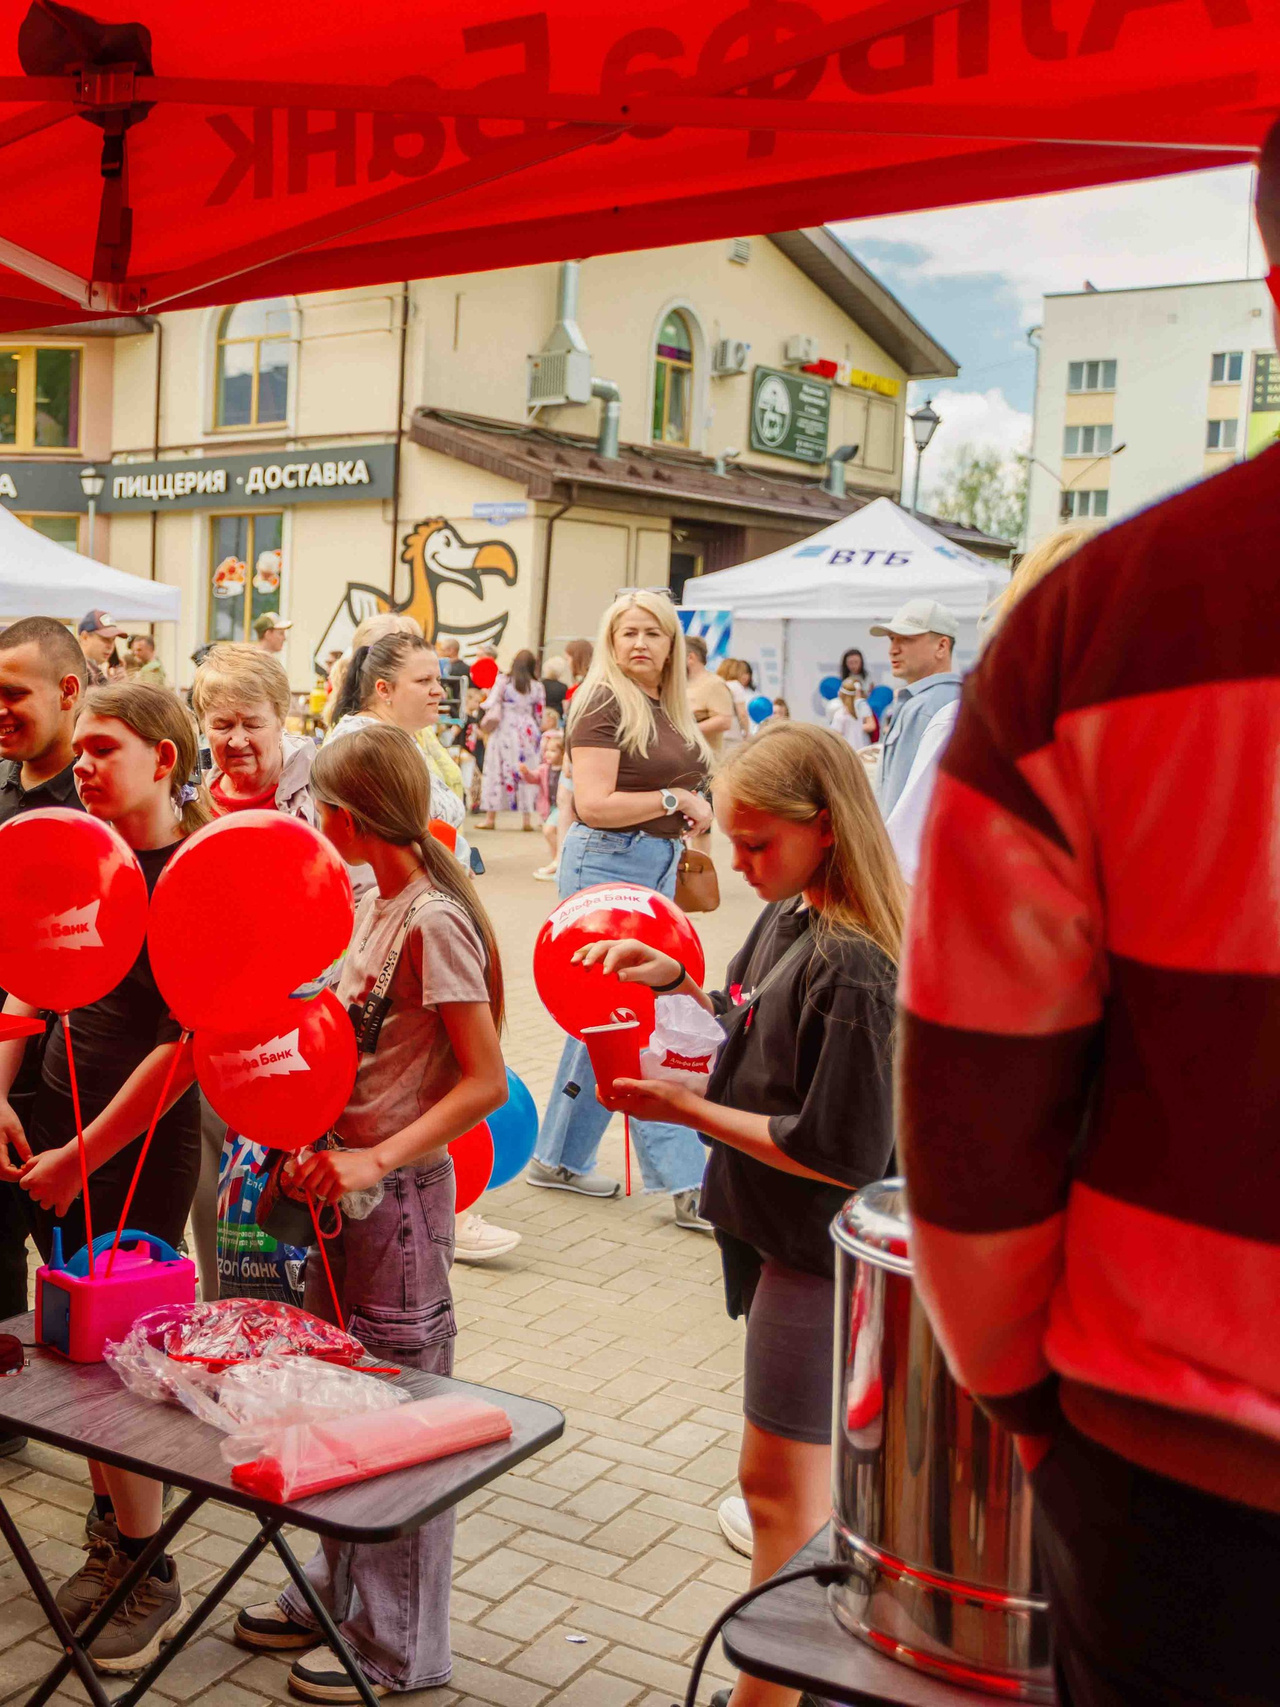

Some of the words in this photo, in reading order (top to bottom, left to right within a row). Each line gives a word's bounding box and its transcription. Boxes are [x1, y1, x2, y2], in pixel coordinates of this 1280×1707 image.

[113, 469, 227, 500] ПИЦЦЕРИЯ
[245, 459, 371, 495] ДОСТАВКА
[827, 548, 914, 567] ВТБ
[558, 897, 602, 921] Альфа
[604, 894, 641, 903] Банк
[259, 1047, 294, 1066] Банк
[218, 1257, 239, 1278] zon
[240, 1256, 280, 1278] банк
